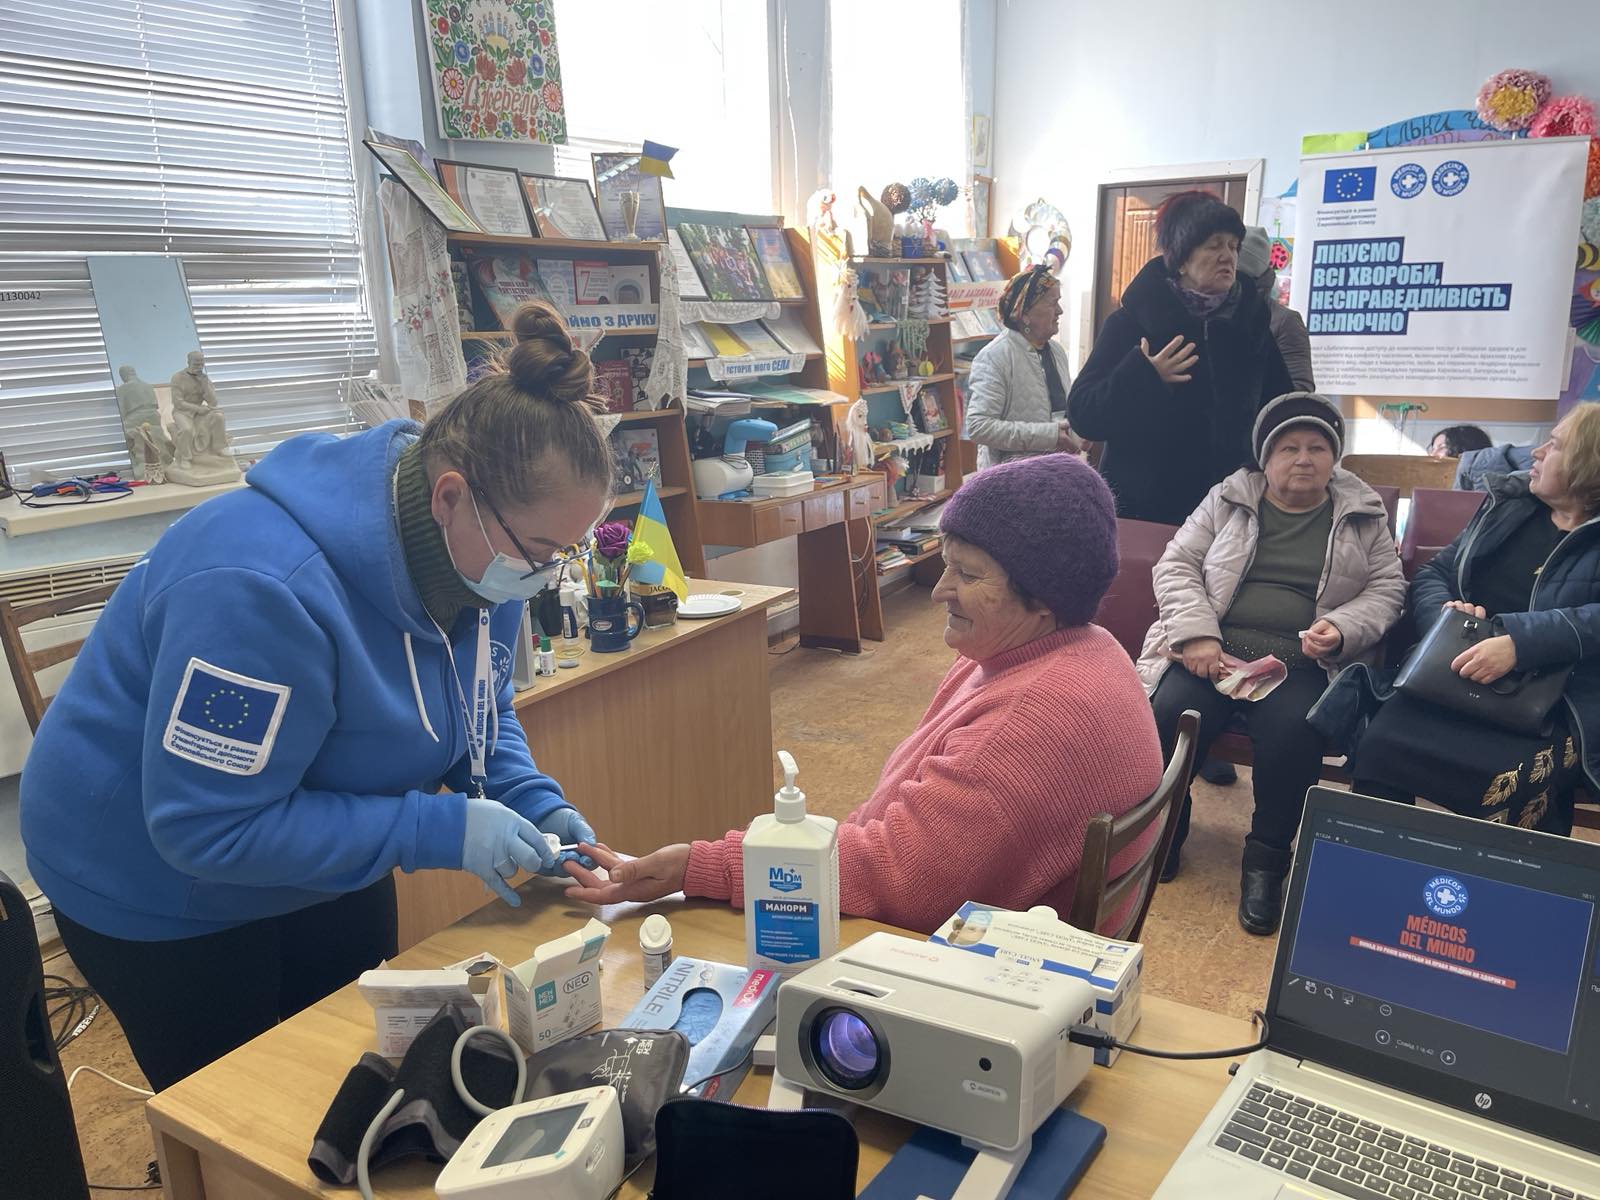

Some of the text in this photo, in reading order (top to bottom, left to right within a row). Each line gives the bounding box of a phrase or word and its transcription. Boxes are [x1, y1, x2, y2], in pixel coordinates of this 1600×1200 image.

[1314, 241, 1401, 265] ЛІКУЄМО
[1313, 264, 1440, 288] ВСІ ХВОРОБИ,
[1310, 286, 1507, 312] НЕСПРАВЕДЛИВІСТЬ
[618, 314, 656, 328] ДРУКУ
[1309, 311, 1405, 333] ВКЛЮЧНО
[772, 359, 791, 372] СЕЛА
[174, 725, 223, 748] Фінансується
[230, 745, 258, 756] рамках
[226, 760, 252, 771] Союзу
[765, 902, 808, 913] МАНОРМ
[1434, 904, 1462, 915] MUNDO
[1406, 914, 1467, 944] MÉDICOS
[1400, 930, 1475, 963] DEL MUNDO
[566, 974, 590, 991] NEO
[538, 1029, 552, 1041] 50
[1476, 1093, 1492, 1109] hp
